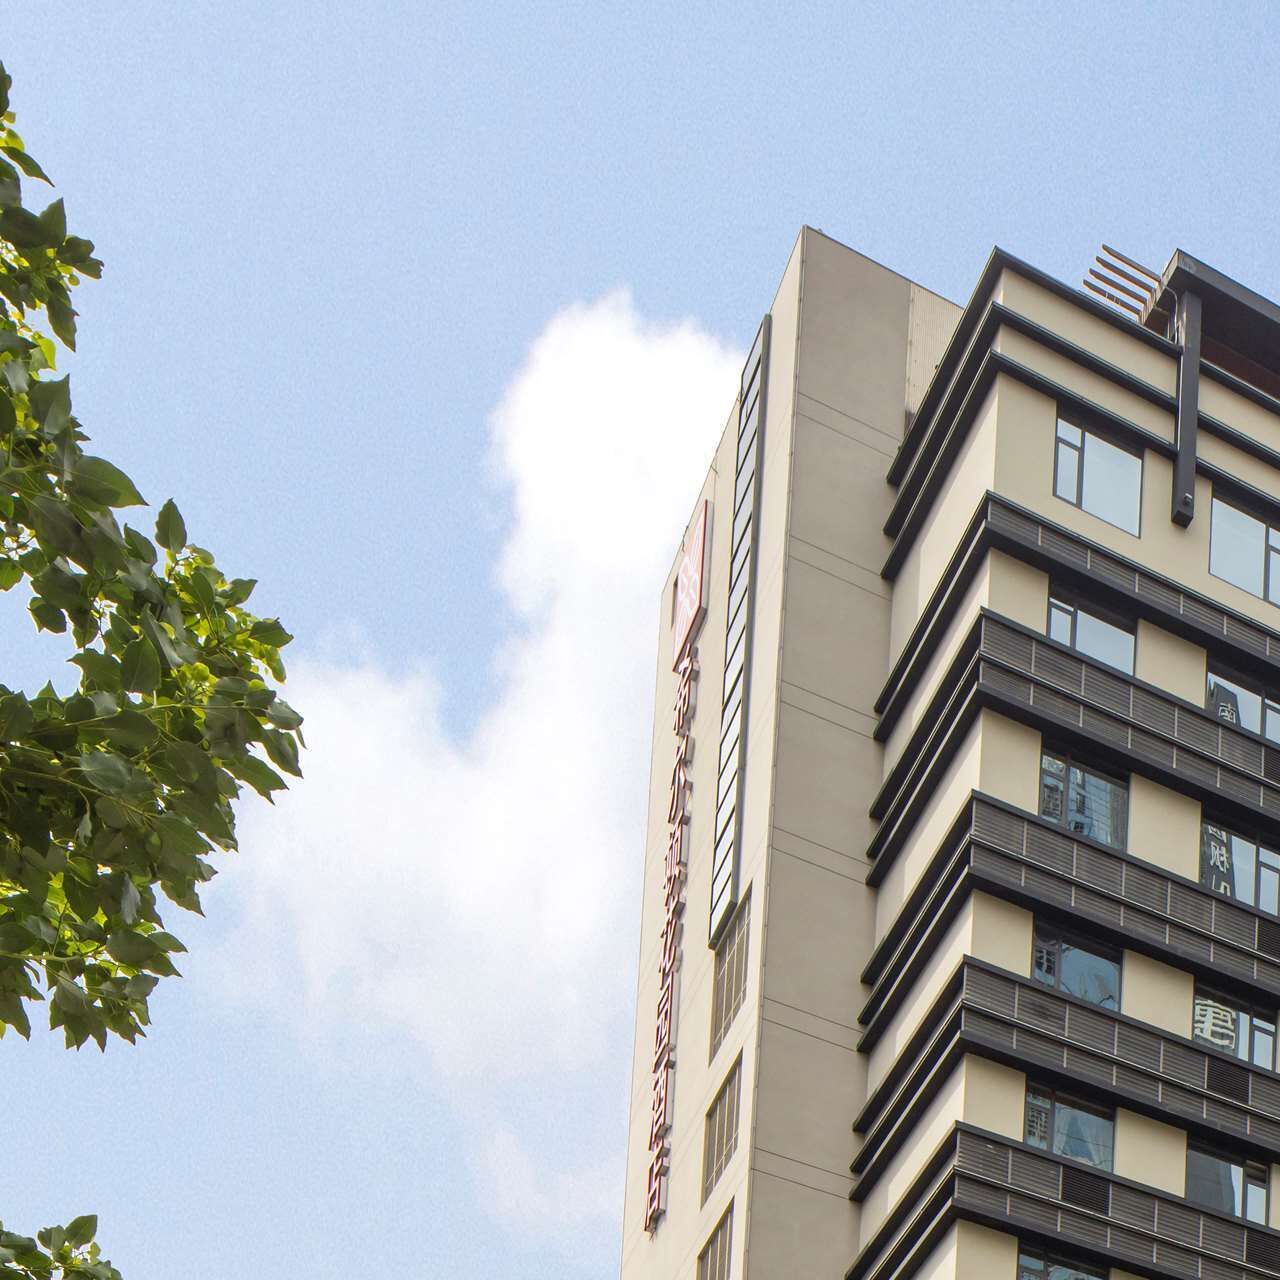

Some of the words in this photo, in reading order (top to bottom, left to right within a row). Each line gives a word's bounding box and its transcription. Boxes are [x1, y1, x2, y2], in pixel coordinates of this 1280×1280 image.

[644, 642, 699, 1235] 希尔顿花园酒店
